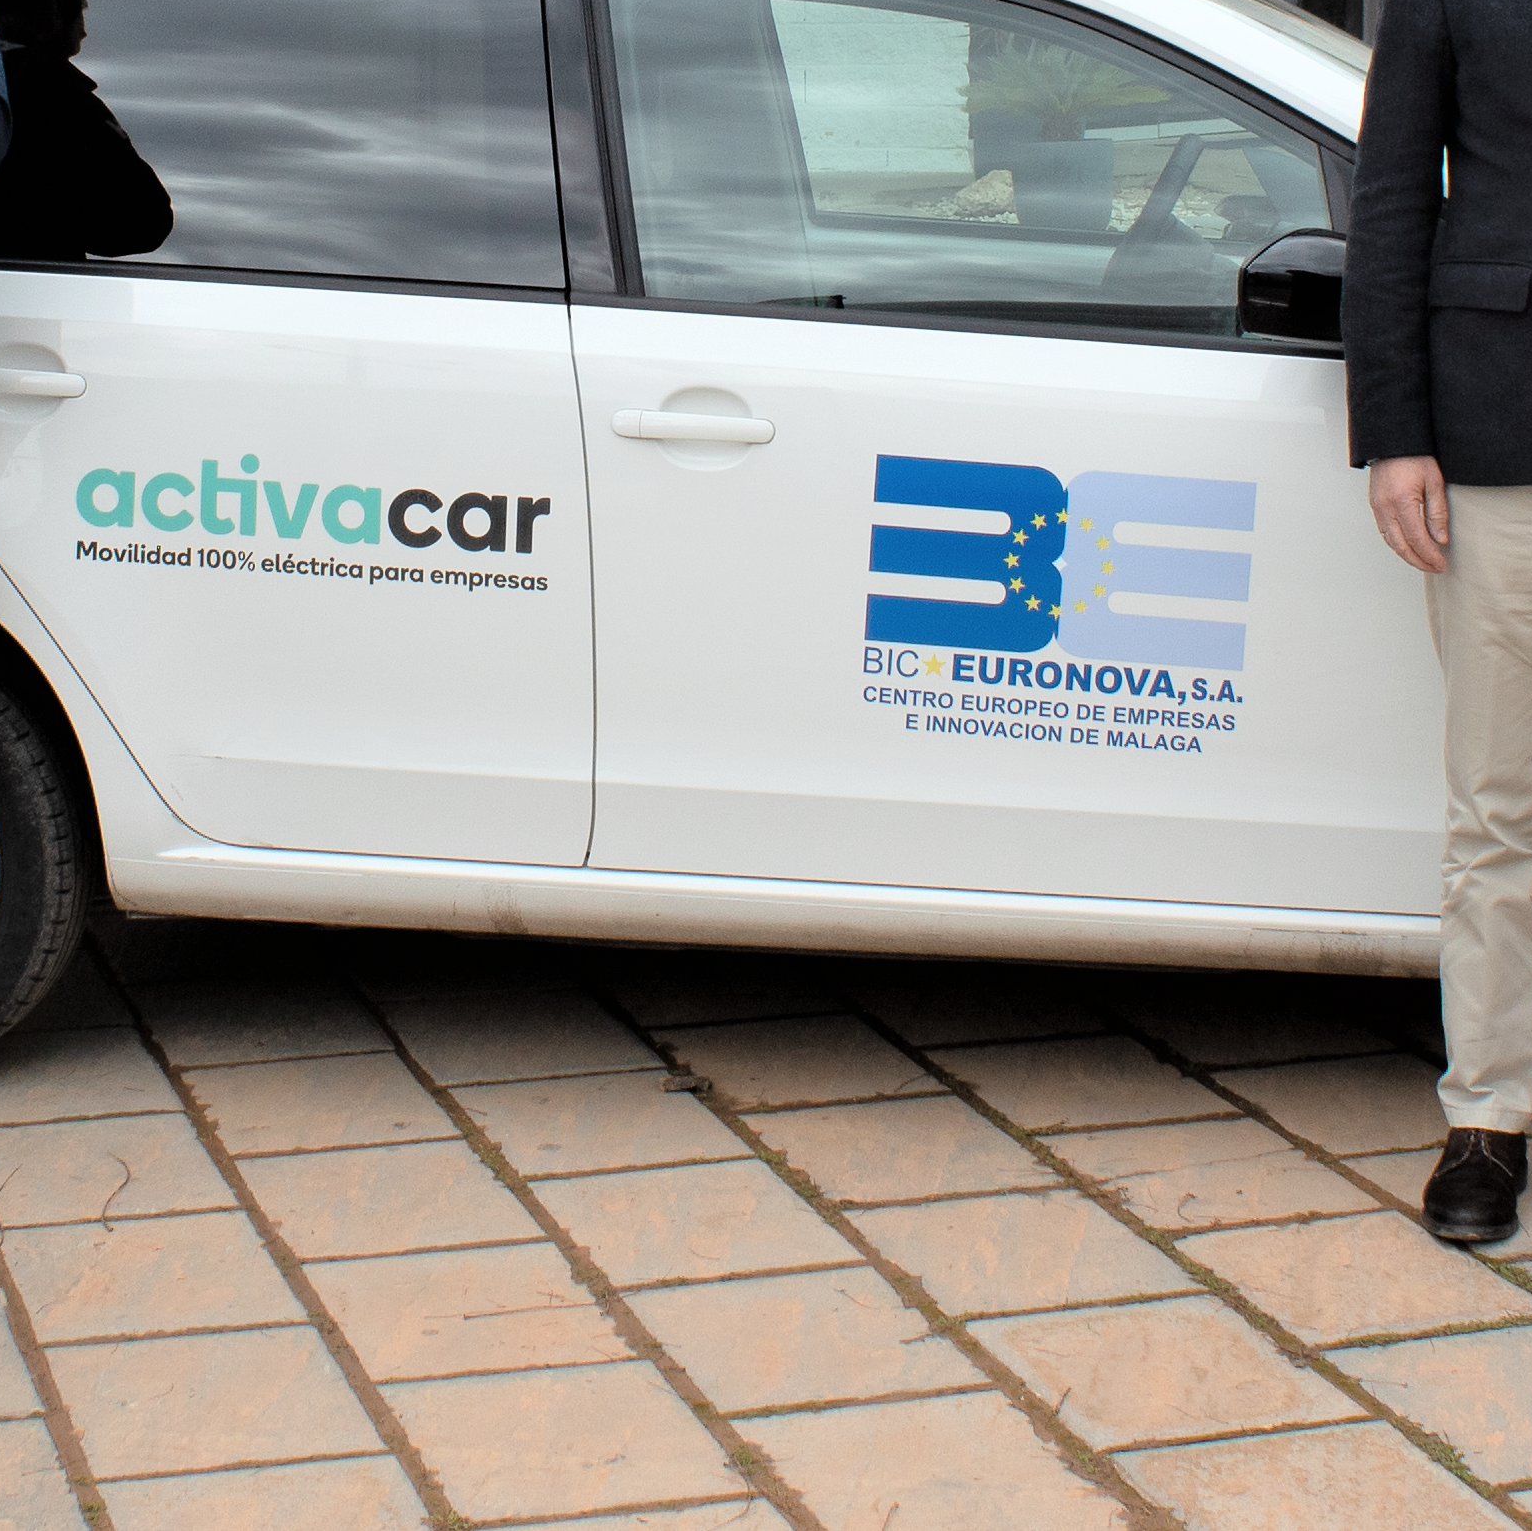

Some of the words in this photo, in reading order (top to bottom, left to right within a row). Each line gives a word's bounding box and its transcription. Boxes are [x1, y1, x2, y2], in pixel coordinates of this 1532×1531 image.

[75, 453, 551, 555] activacar
[75, 540, 192, 567] Movilidad
[196, 547, 256, 573] 100%
[260, 553, 364, 579] eléctrica
[369, 565, 424, 586] para
[429, 569, 549, 593] empresas
[863, 646, 919, 679] BIC
[863, 685, 954, 710] CENTRO
[961, 694, 1070, 720] EUROPEO
[1076, 703, 1107, 723] DE
[1113, 706, 1236, 732] EMPRESAS
[905, 713, 919, 731] E
[926, 715, 1063, 743] INNOVACION
[1069, 727, 1100, 746] DE
[1106, 730, 1203, 754] MALAGA
